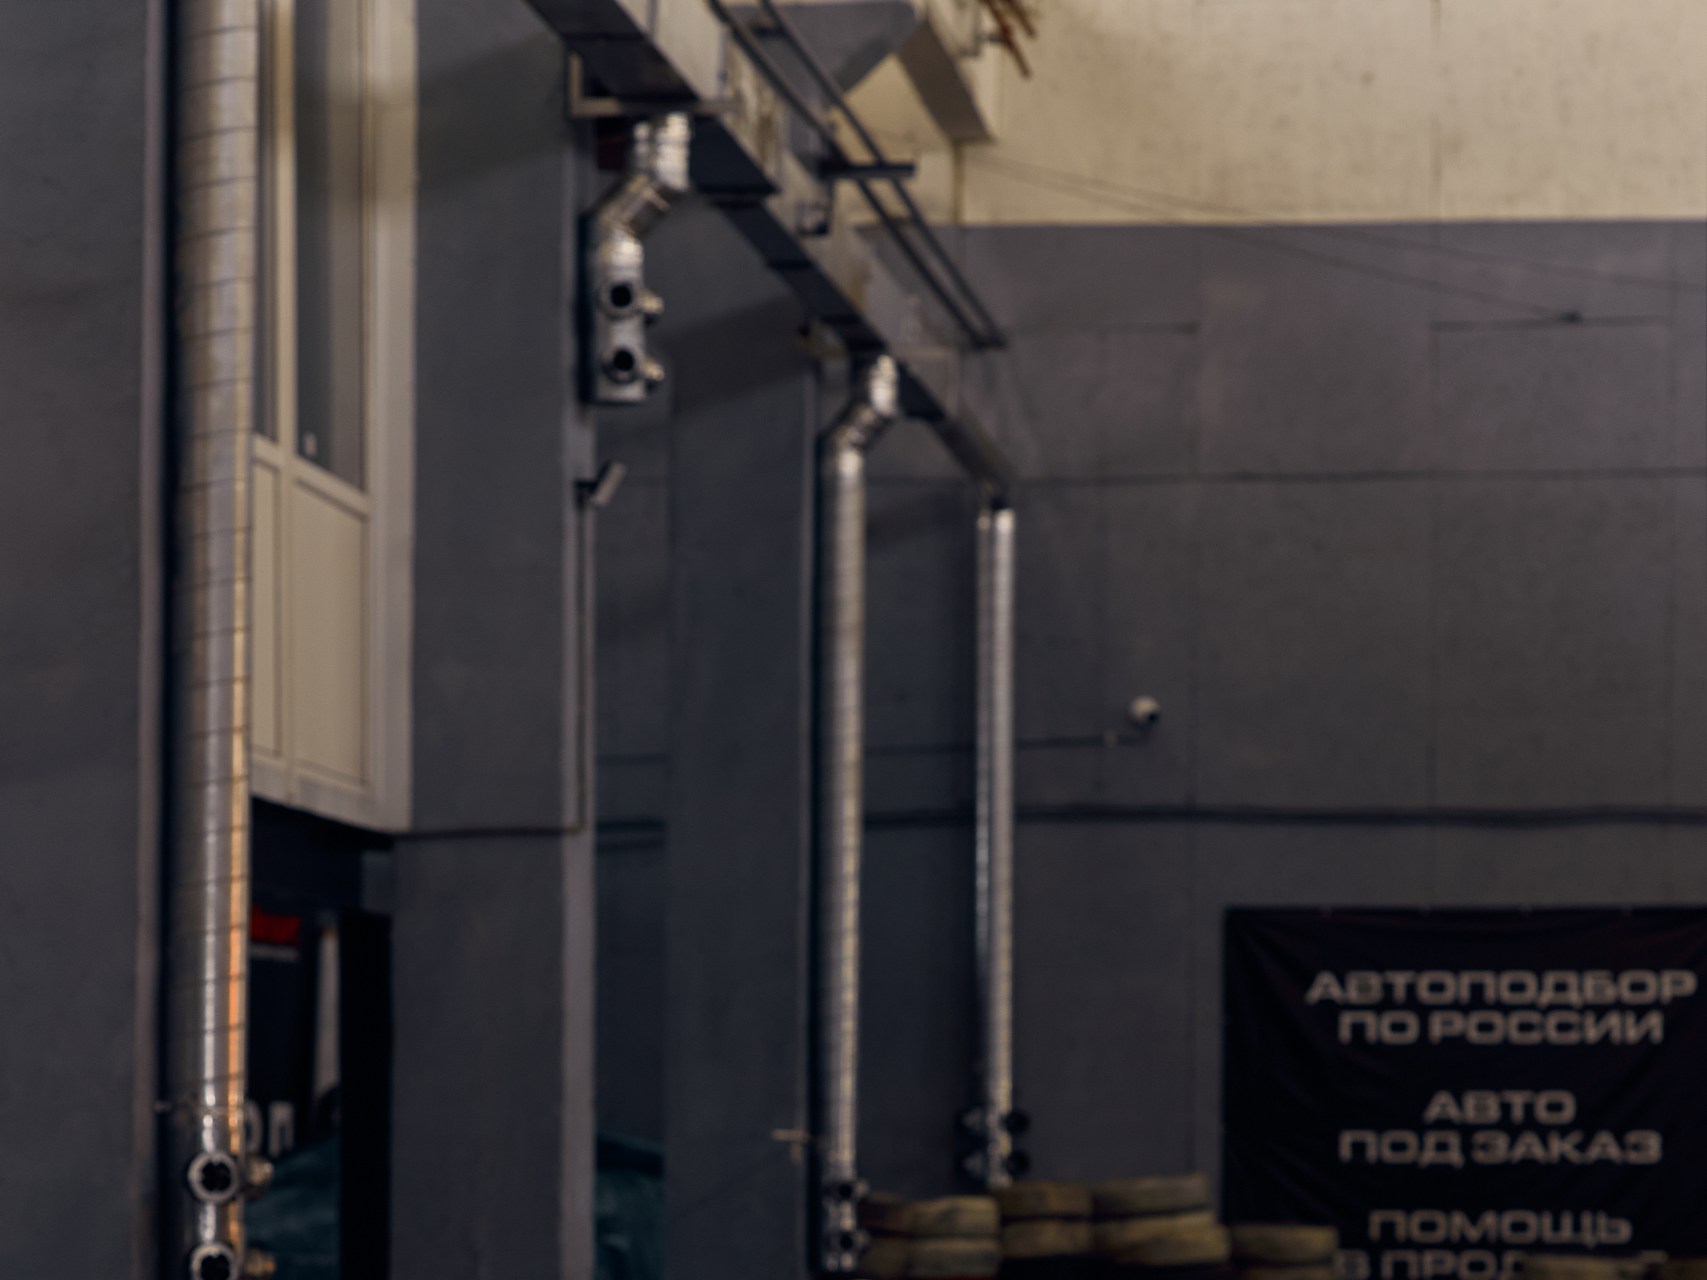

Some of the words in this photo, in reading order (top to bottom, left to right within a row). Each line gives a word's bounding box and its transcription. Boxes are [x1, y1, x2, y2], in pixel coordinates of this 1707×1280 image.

[1305, 970, 1698, 1008] АВТОПОДБОР
[1338, 1010, 1419, 1044] ПО
[1429, 1010, 1664, 1044] РОССИИ
[1424, 1090, 1576, 1124] АВТО
[1338, 1130, 1465, 1168] ПОД
[1471, 1130, 1663, 1164] ЗАКАЗ
[1369, 1209, 1632, 1249] ПОМОЩЬ
